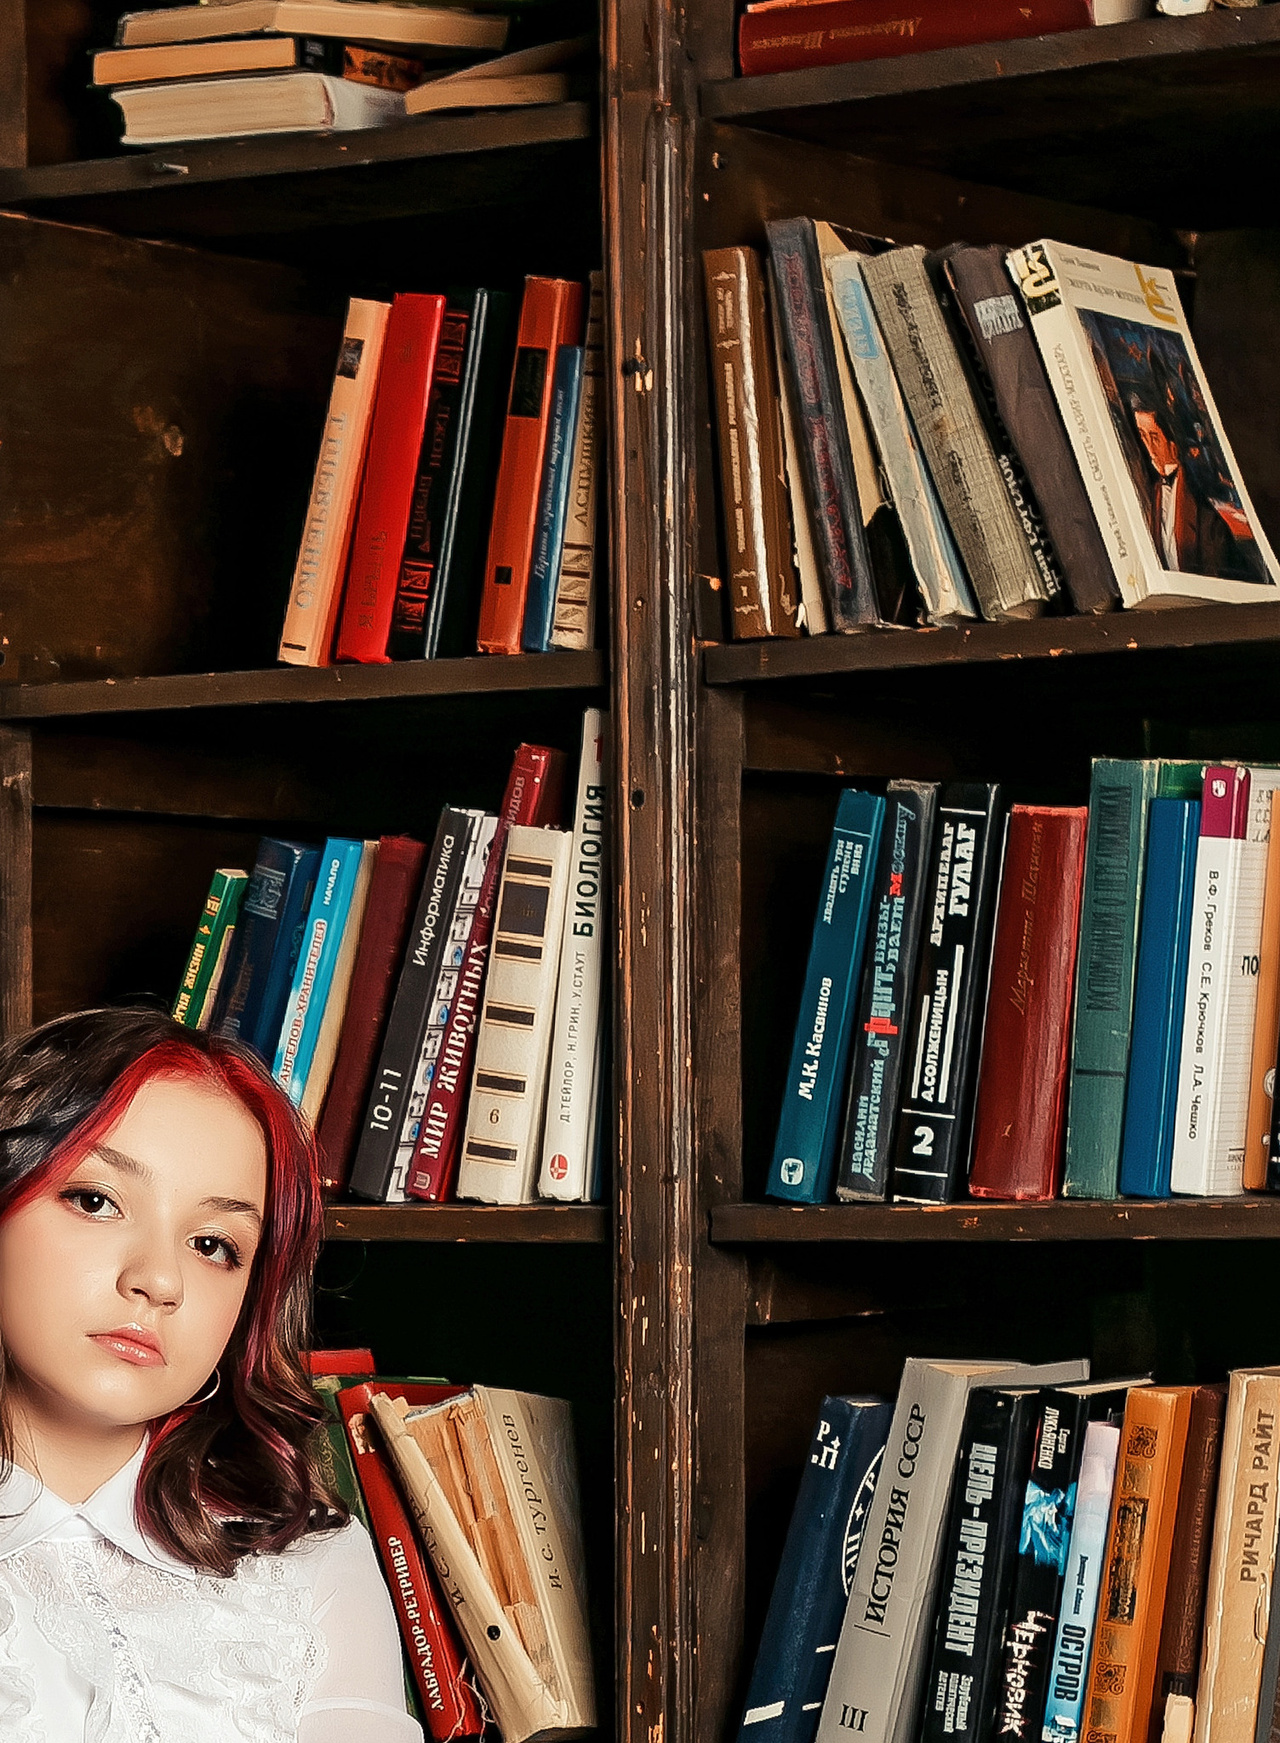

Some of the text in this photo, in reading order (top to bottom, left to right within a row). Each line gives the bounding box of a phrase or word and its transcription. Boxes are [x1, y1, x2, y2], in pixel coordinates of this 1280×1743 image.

[323, 859, 340, 906] НАЧАЛО
[573, 783, 611, 937] БИОЛОГИЯ
[930, 822, 954, 946] АРХИПЕЛАГ
[948, 822, 976, 916] ГУЛАГ
[183, 943, 205, 990] ЖИЗНИ
[370, 835, 455, 1131] 10-11 Информатика
[1188, 870, 1219, 1140] В.Ф. Греков С.Е. Крючков Л.А. Чешко
[420, 1102, 448, 1159] МИР
[437, 941, 494, 1092] ЖИВОТНЫХ
[798, 977, 832, 1099] М.К. Касвинов
[921, 969, 949, 1102] А.СОЛЖЕНИЦЫН
[488, 1107, 499, 1124] 6
[912, 1125, 935, 1155] 2
[1037, 1406, 1060, 1470] ЛУКЬЯНЕНКО
[1239, 1409, 1274, 1582] РИЧАРД РАЙТ
[864, 1403, 926, 1623] ИСТОРИЯ СССР
[946, 1444, 997, 1654] ЦЕЛЬ-ПРЕЗИДЕНТ
[388, 1537, 443, 1709] ЛАБРАДОР-РЕТРИВЕР
[1053, 1623, 1086, 1702] ОСТРОВ
[839, 1703, 869, 1732] III
[951, 1674, 974, 1731] Зарубежный
